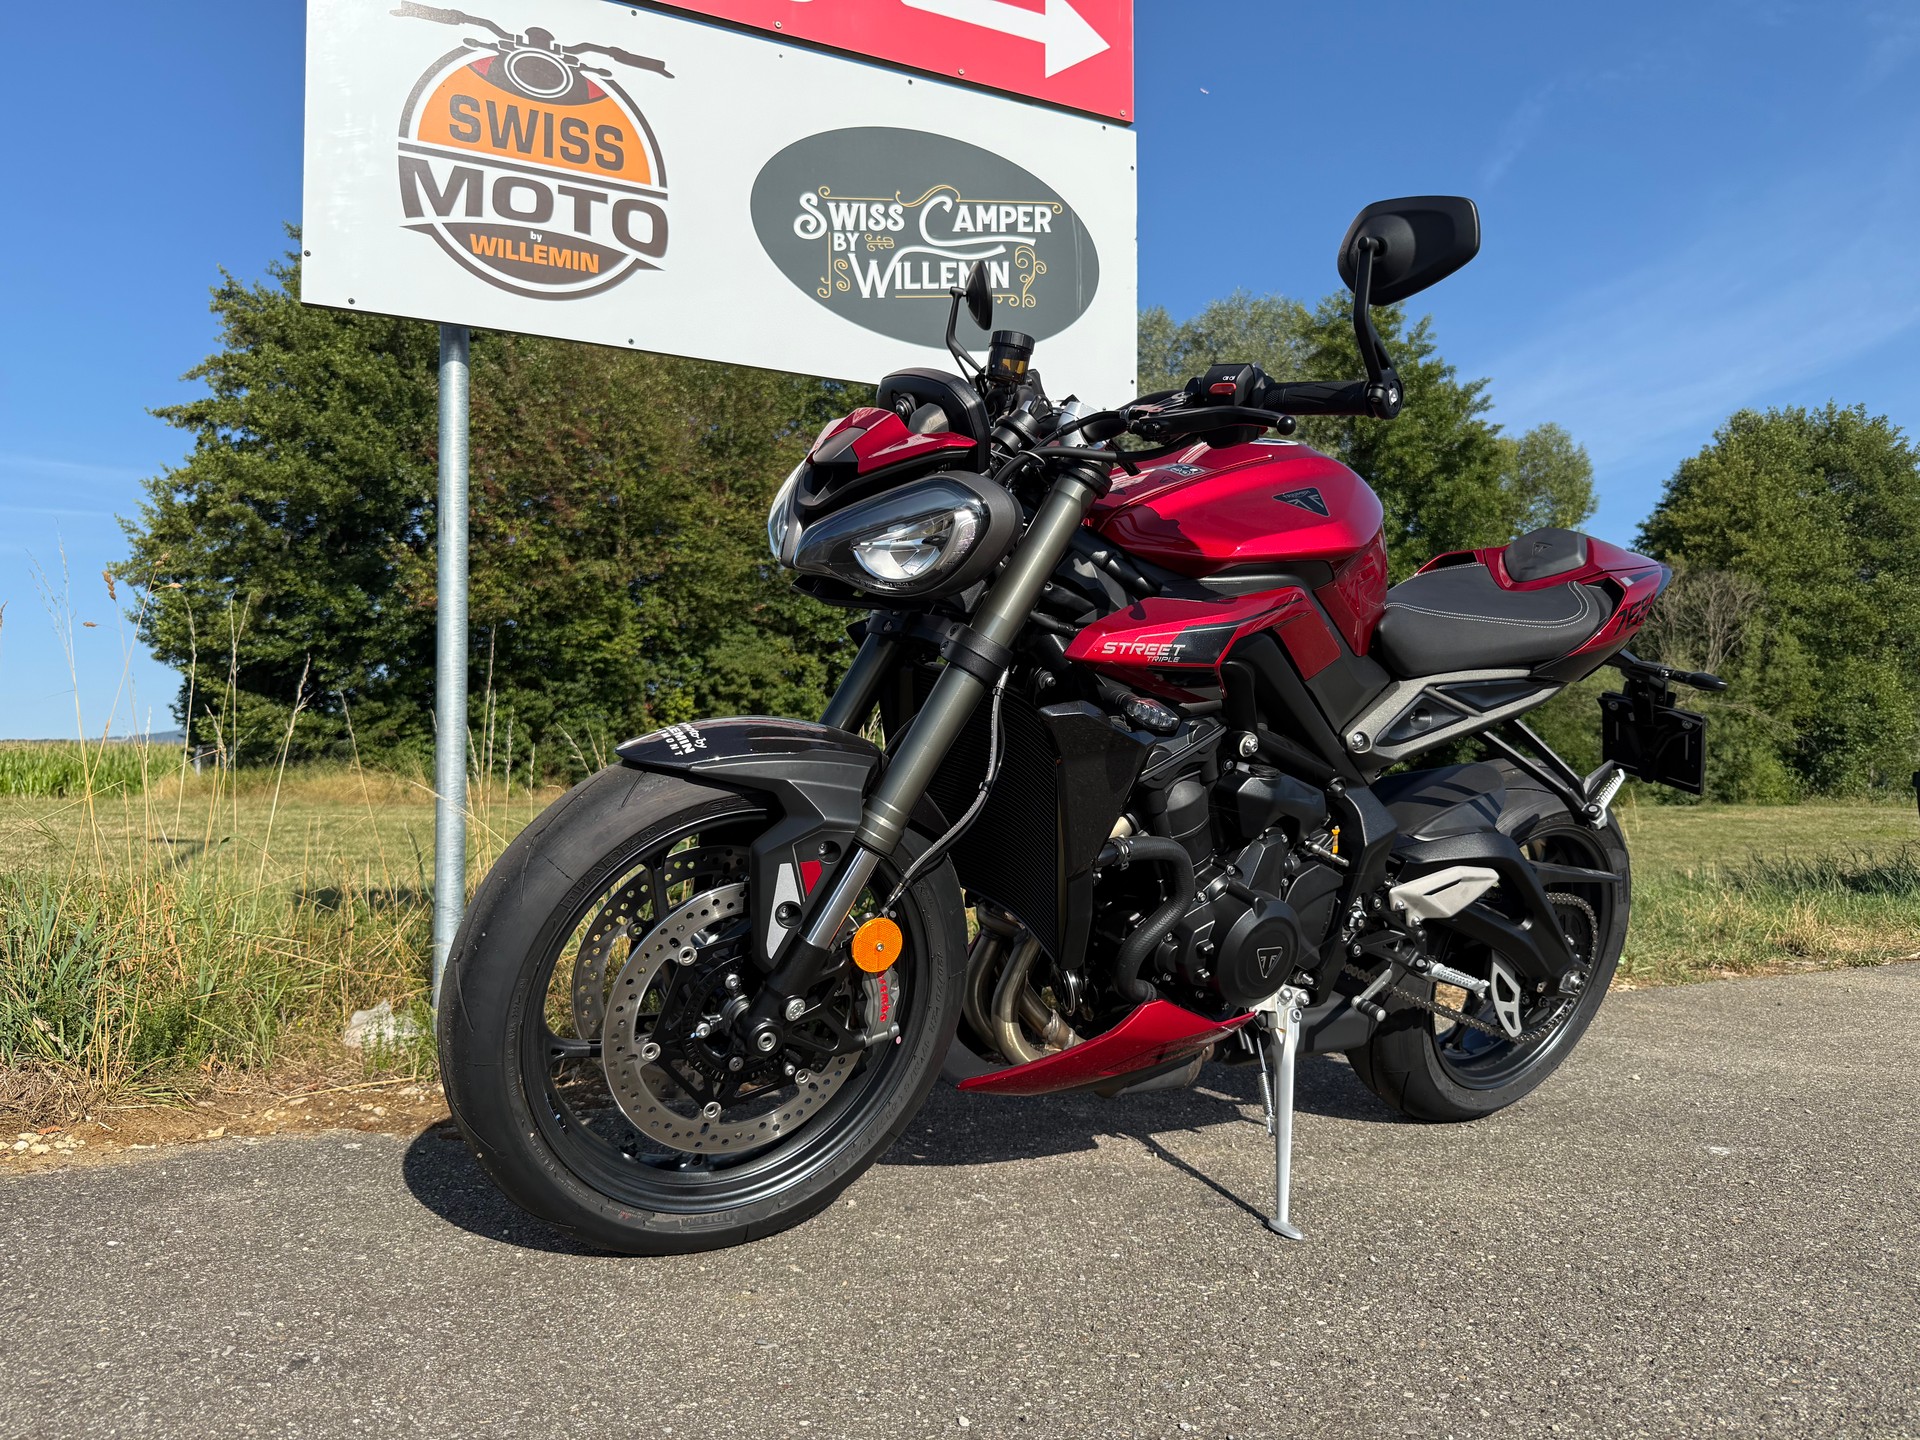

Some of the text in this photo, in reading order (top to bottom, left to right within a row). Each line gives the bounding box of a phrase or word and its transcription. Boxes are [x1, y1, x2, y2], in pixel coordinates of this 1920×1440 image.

[449, 94, 625, 172] SWISS
[398, 155, 669, 259] MOTO
[530, 231, 543, 243] by
[833, 232, 860, 252] BY
[470, 233, 599, 274] WILLEMIN
[848, 245, 1010, 298] WILLEMN
[1101, 641, 1186, 656] STREET
[1146, 655, 1181, 663] TRIPLE
